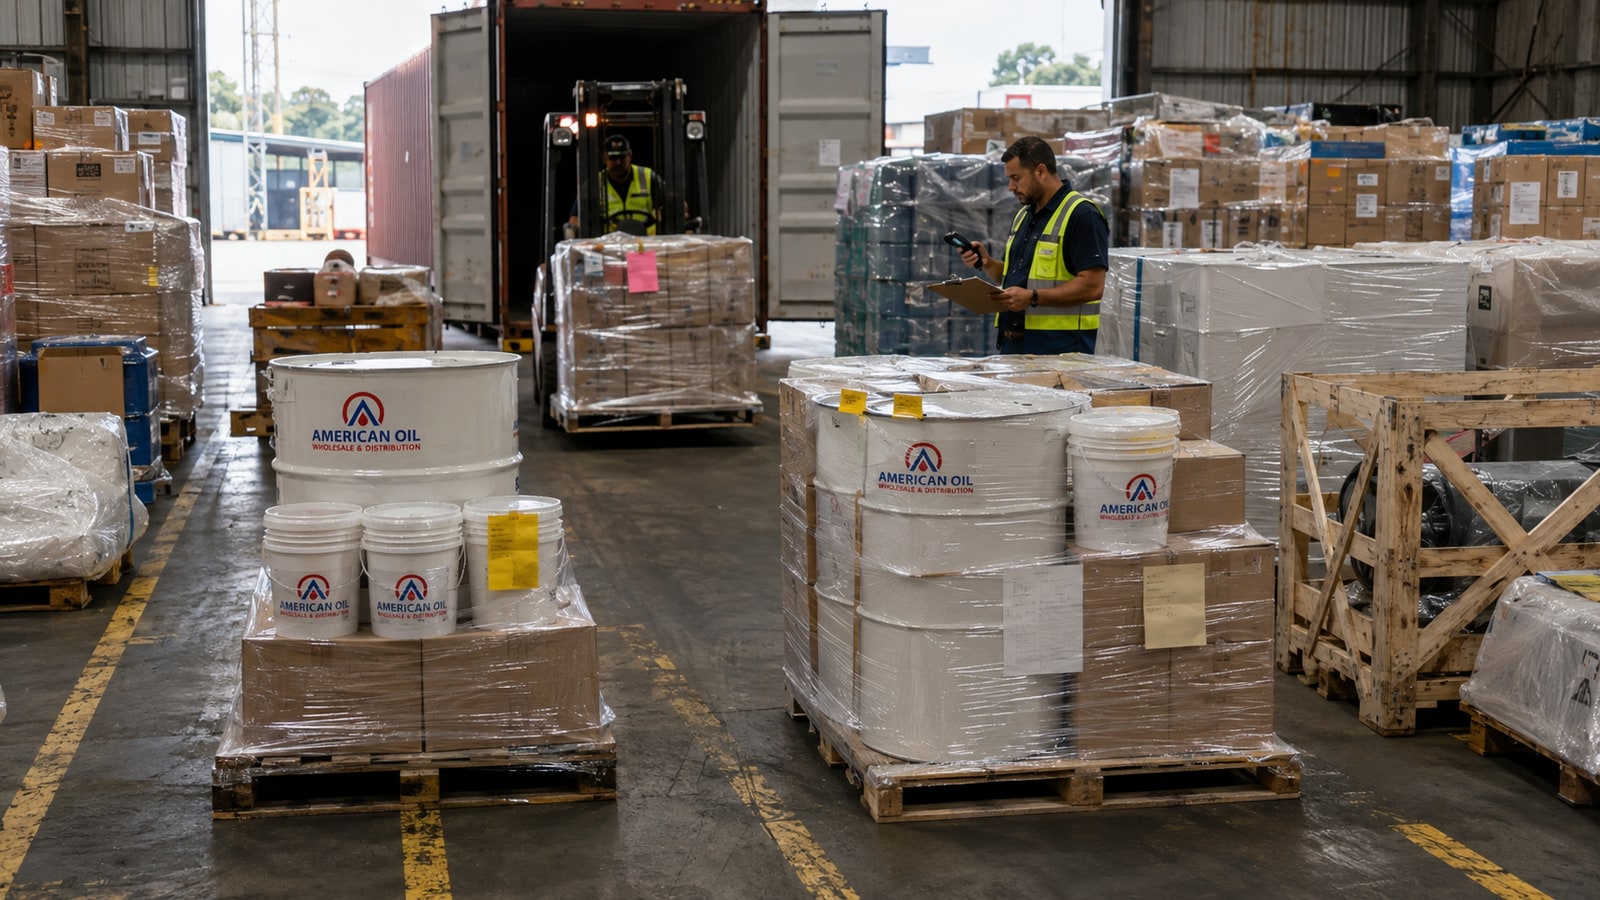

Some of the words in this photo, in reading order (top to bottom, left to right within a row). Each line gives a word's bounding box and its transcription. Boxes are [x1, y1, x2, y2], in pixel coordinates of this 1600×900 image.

[312, 429, 390, 443] AMERICAN
[394, 429, 421, 442] OIL
[312, 443, 354, 452] WHOLESALE
[356, 444, 363, 452] &
[365, 443, 421, 452] DISTRIBUTION
[878, 471, 947, 486] AMERICAN
[950, 475, 974, 486] OIL
[877, 483, 915, 493] WHOLESALE
[1100, 502, 1159, 514] AMERICAN
[280, 600, 333, 612] AMERICAN
[335, 600, 350, 610] OIL
[377, 601, 431, 613] AMERICAN
[433, 600, 447, 610] OIL
